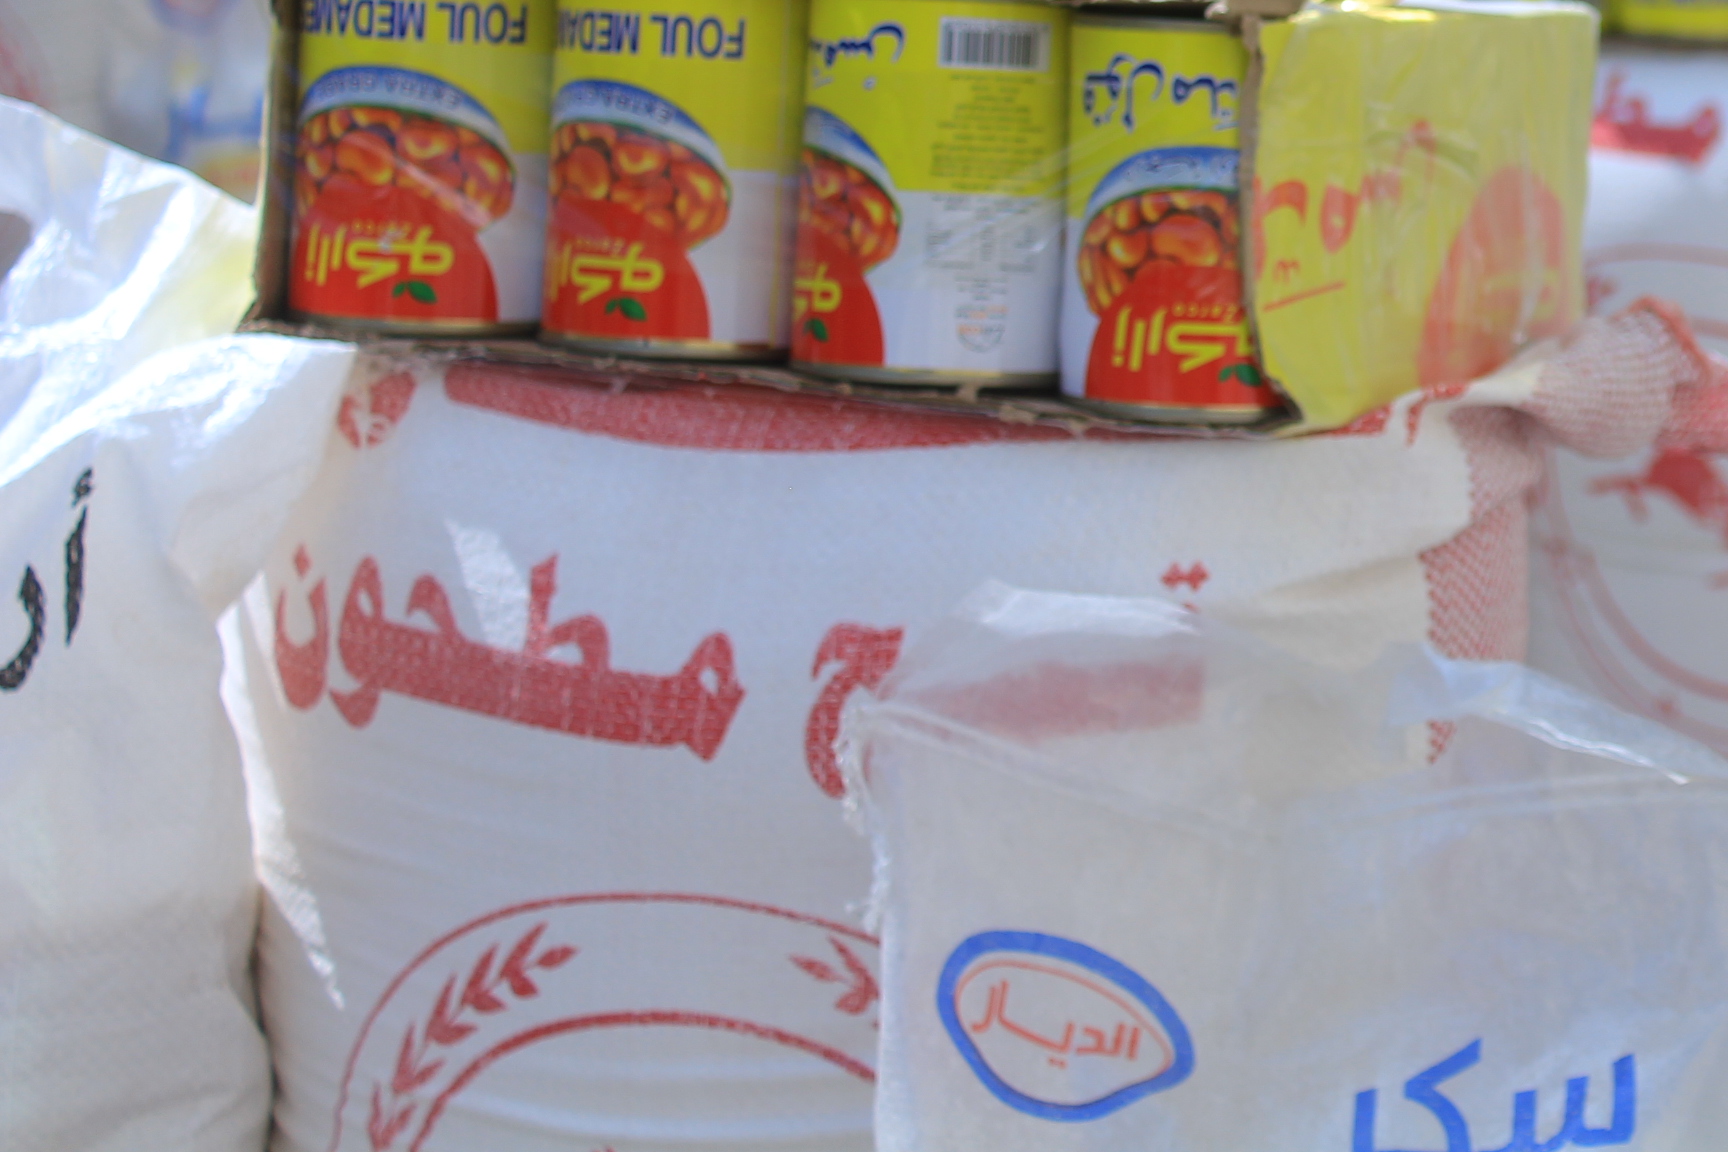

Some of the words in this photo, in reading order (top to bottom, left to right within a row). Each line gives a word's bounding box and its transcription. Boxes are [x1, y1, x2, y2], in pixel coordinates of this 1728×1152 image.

[436, 1, 528, 44] FOUL
[658, 14, 747, 59] FOUL
[305, 223, 455, 289] زاركو
[972, 978, 1138, 1070] الديار
